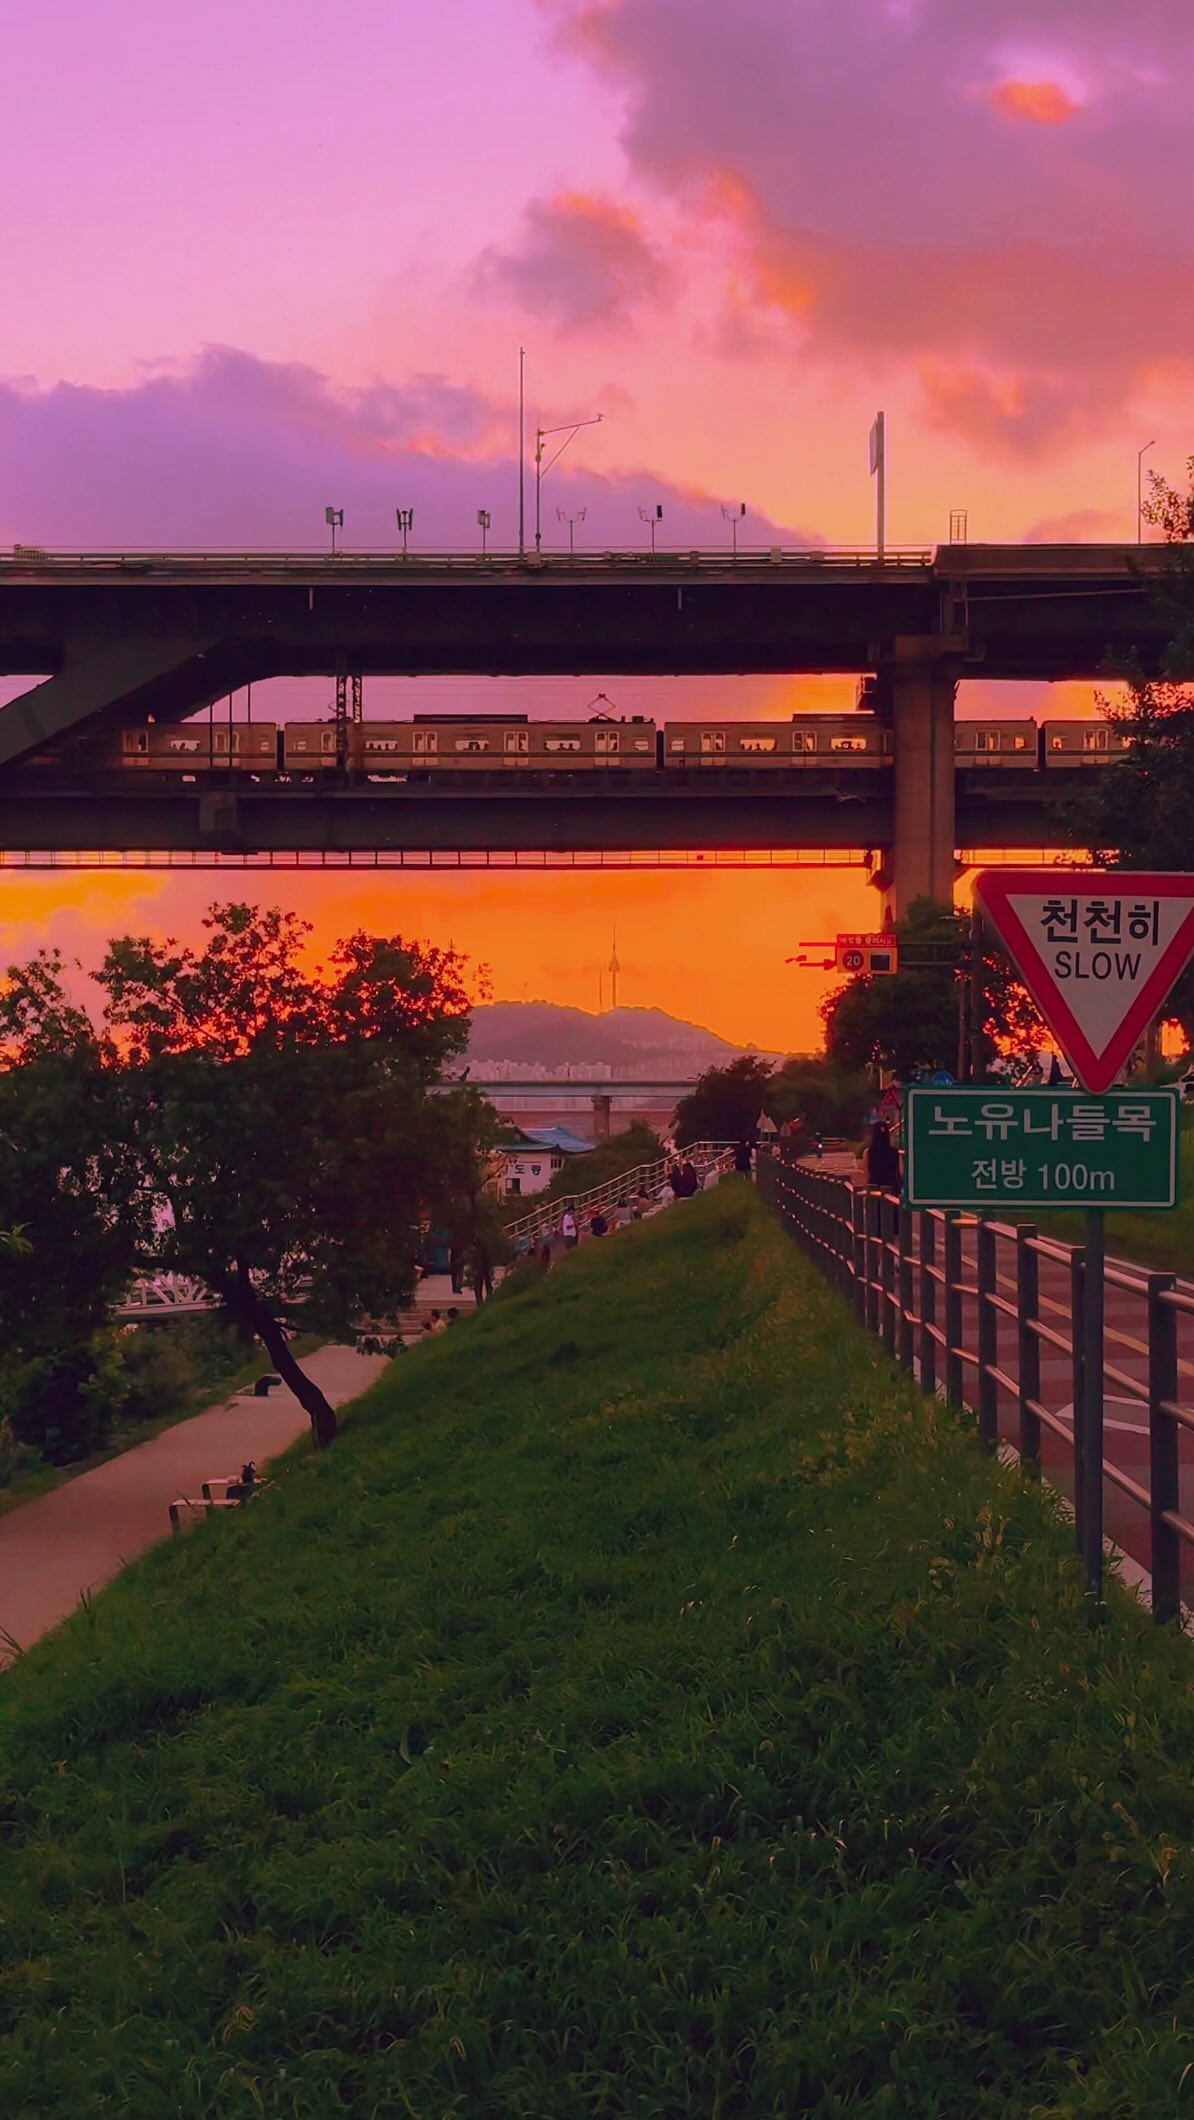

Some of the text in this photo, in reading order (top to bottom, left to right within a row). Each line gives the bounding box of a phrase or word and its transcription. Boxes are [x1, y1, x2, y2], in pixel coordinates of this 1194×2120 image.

[1040, 899, 1160, 946] 천천히
[846, 955, 861, 967] 20
[1054, 951, 1142, 980] SLOW
[928, 1103, 1157, 1143] 노유나들목
[971, 1158, 1115, 1191] 전방 100m
